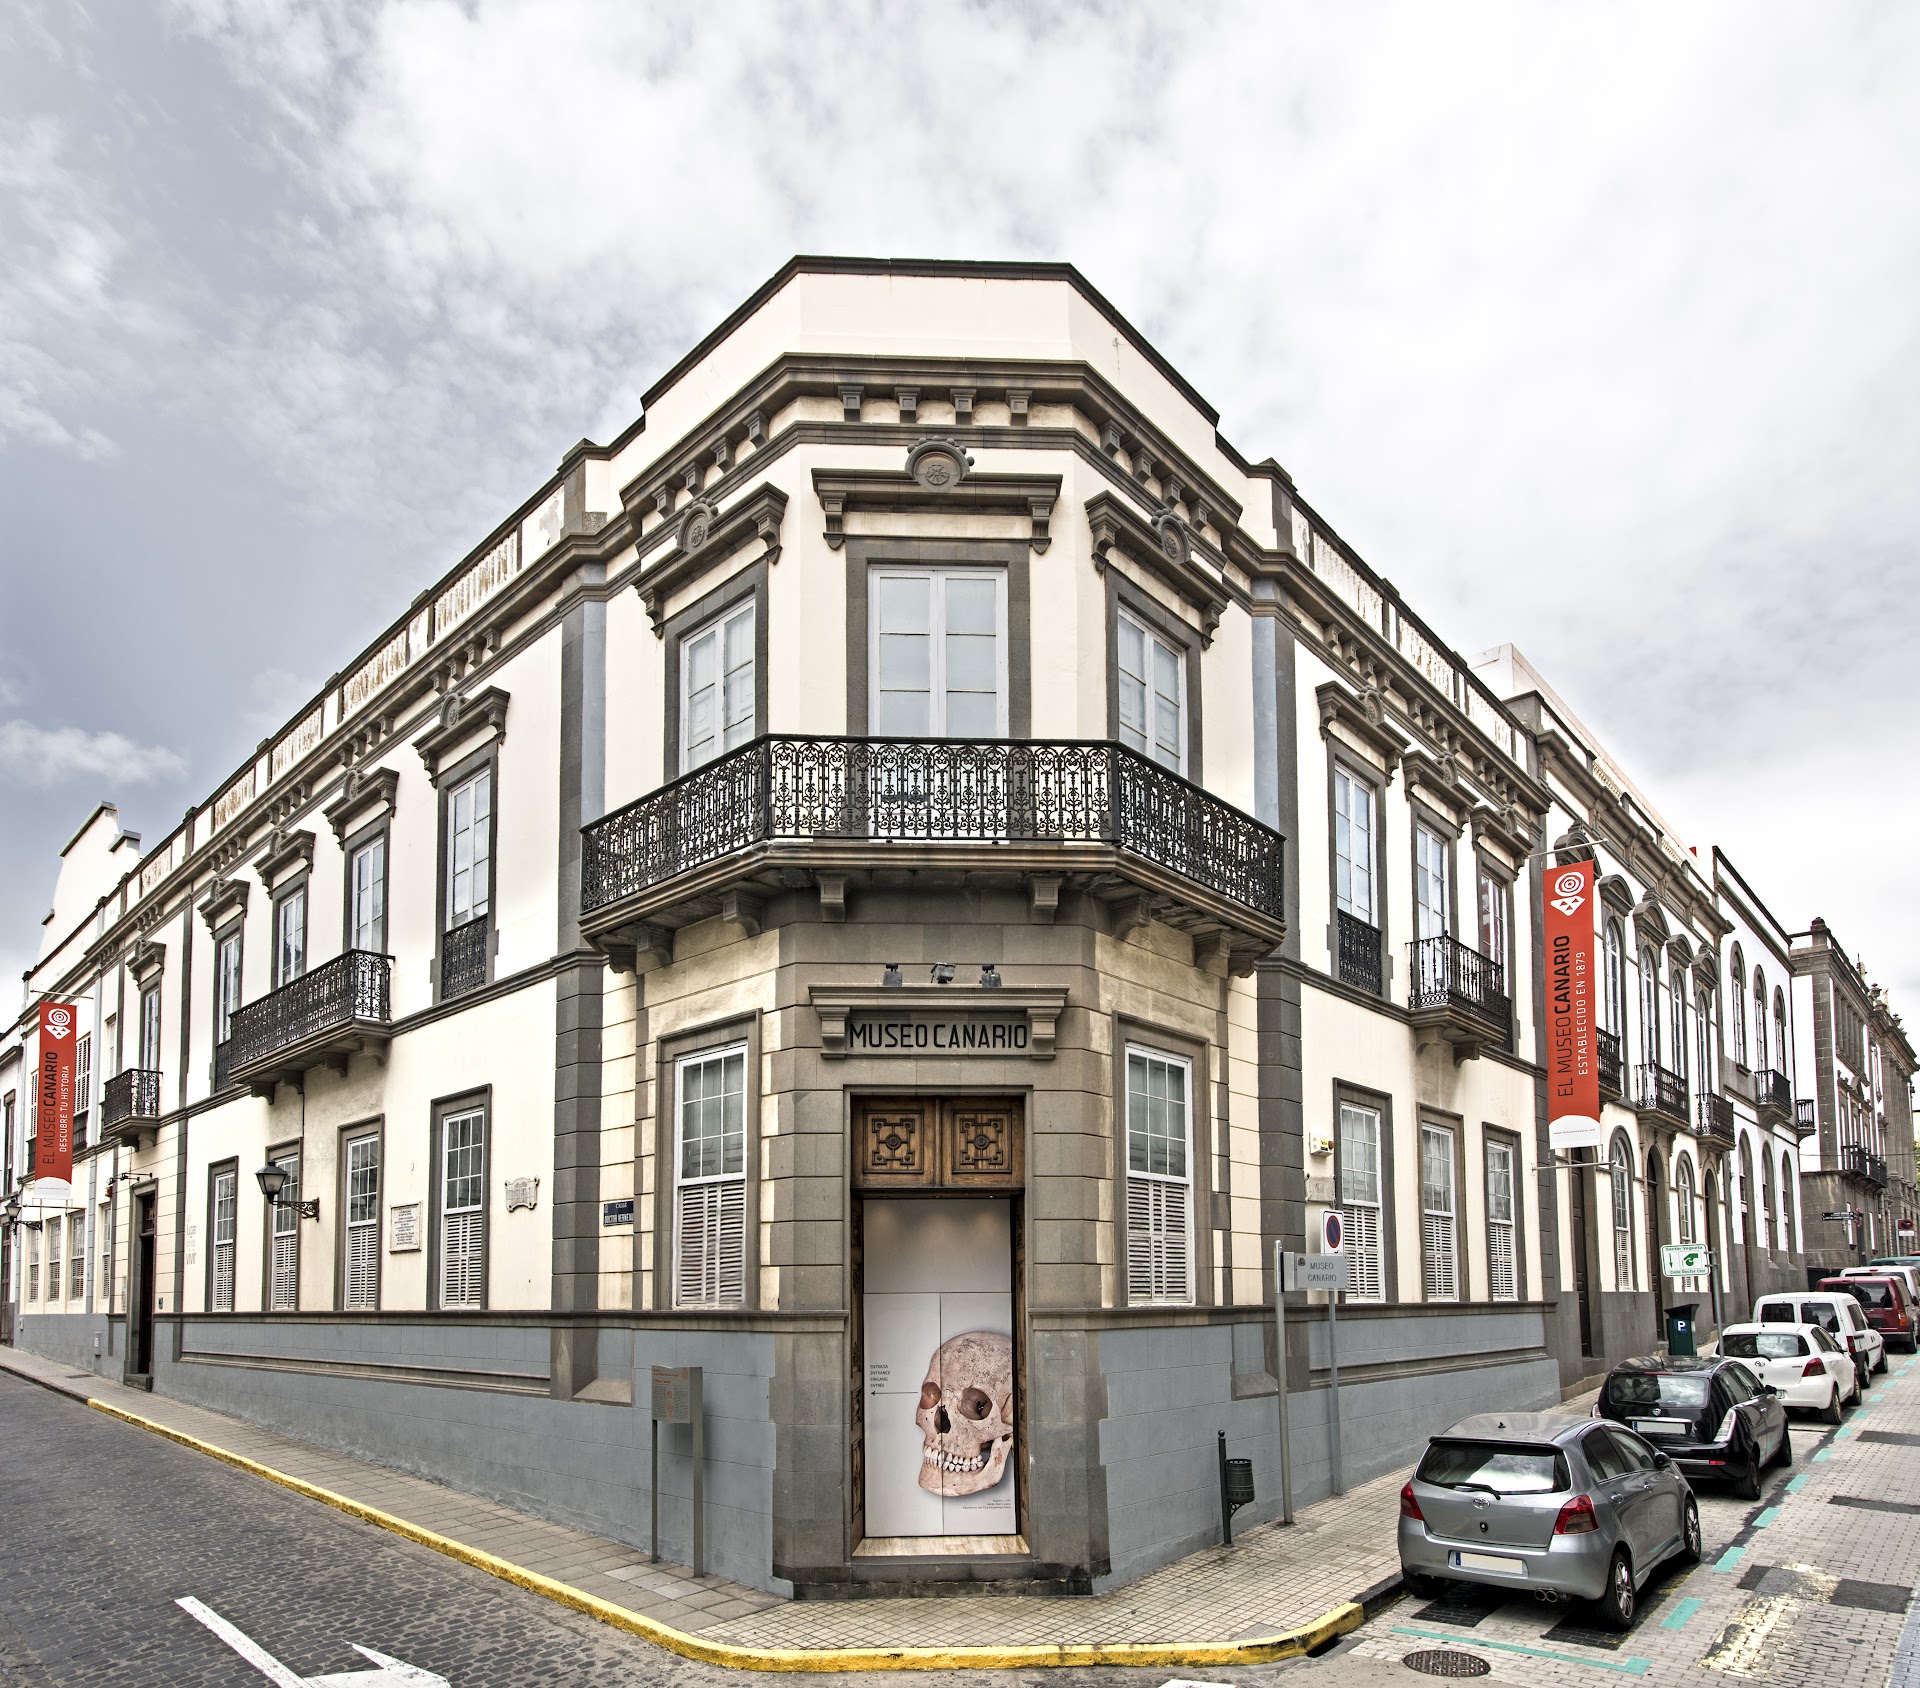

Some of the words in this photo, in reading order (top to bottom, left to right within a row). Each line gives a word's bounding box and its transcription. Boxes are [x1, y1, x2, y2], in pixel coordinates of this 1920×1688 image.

[1575, 951, 1586, 977] 1879
[1575, 980, 1586, 995] EN
[849, 1023, 928, 1048] MUSEO
[933, 1023, 1028, 1048] CANARIO
[1576, 999, 1588, 1075] ESTABLECIDO
[60, 1065, 70, 1100] HISTORIA
[1557, 1077, 1574, 1097] EL
[60, 1101, 69, 1111] TU
[59, 1113, 68, 1152] DESCUBRE
[42, 1151, 55, 1164] EL
[1309, 1262, 1334, 1270] MUSEO
[1307, 1274, 1337, 1282] CANARIO
[1677, 1320, 1685, 1331] P
